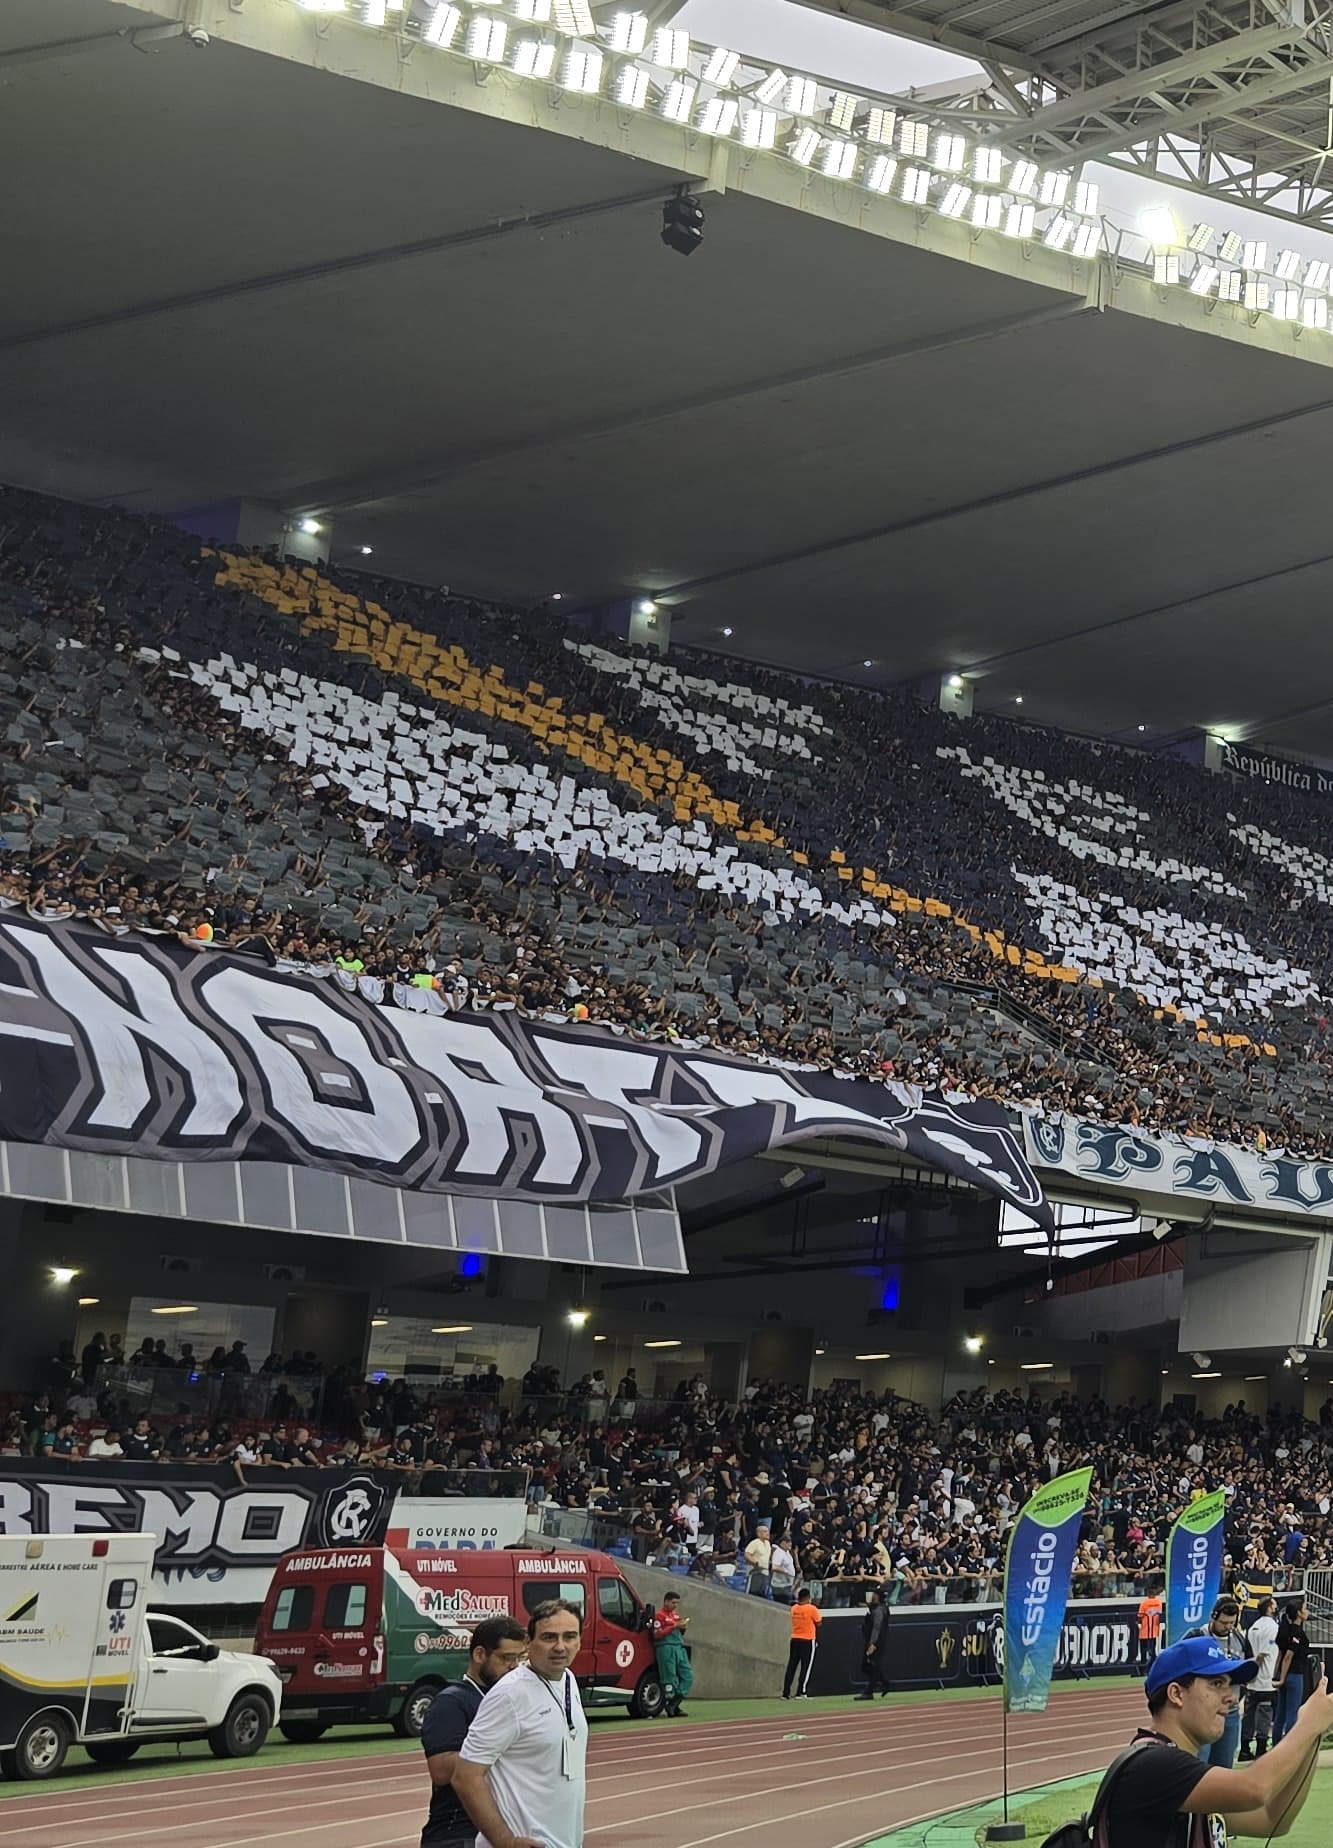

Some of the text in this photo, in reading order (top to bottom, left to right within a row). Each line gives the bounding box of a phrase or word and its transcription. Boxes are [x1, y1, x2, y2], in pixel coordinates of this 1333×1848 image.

[416, 1526, 498, 1537] GOVERNO DO
[286, 1553, 372, 1572] AMBULÂNCIA
[417, 1556, 457, 1573] UTI MÓVEL
[518, 1556, 587, 1575] AMBULÂNCIA
[1184, 1536, 1209, 1622] Estácio
[1021, 1532, 1058, 1646] Estácio
[435, 1613, 468, 1621] REMOÇÕES
[109, 1637, 131, 1650] UTI
